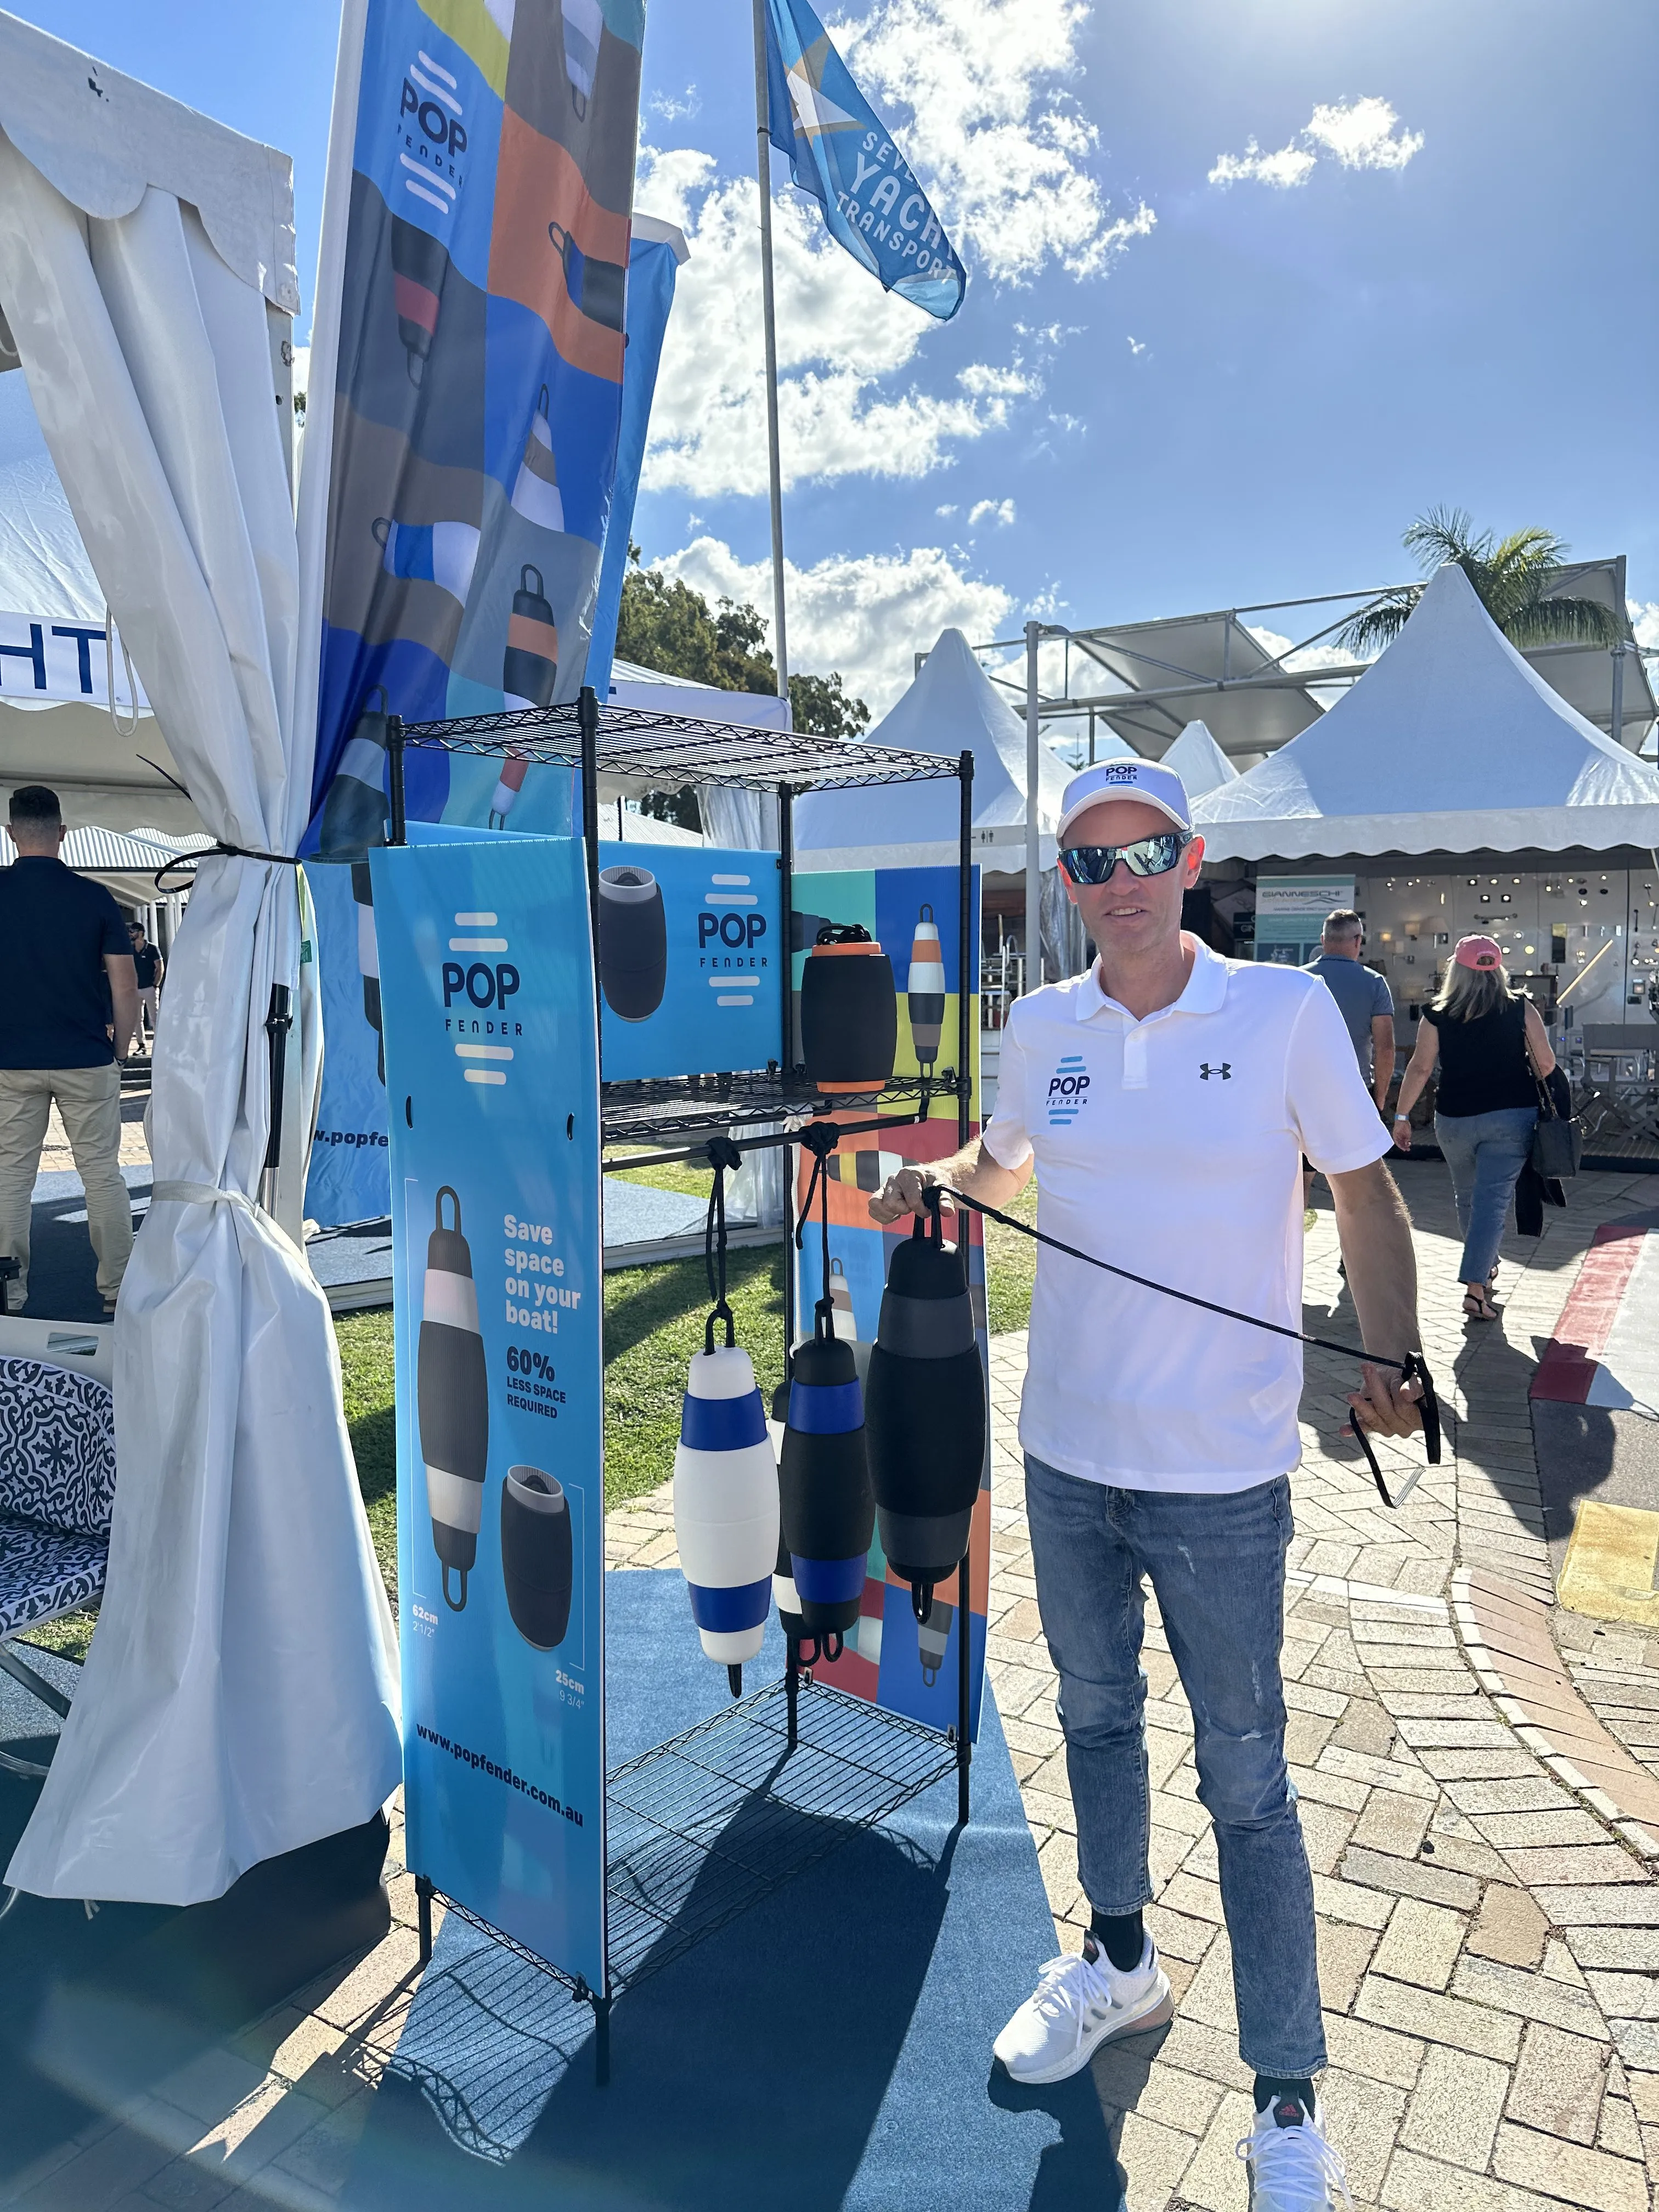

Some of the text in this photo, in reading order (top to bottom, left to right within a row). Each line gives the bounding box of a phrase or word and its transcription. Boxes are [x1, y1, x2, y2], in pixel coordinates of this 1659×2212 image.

[400, 77, 467, 157] POP
[397, 123, 463, 189] FENDER
[836, 191, 956, 284] TRANSPORT
[1106, 766, 1137, 776] POP
[698, 913, 766, 949] POP
[700, 957, 768, 968] FENDER
[442, 962, 520, 1010] POP
[445, 1018, 523, 1036] FENDER
[1048, 1076, 1090, 1097] POP
[504, 1214, 553, 1245] Save
[504, 1248, 565, 1277] space
[505, 1277, 581, 1310] on your
[506, 1300, 558, 1334] boat!
[506, 1346, 555, 1382] 60%
[507, 1375, 566, 1404] LESS SPACE
[507, 1393, 558, 1419] REQUIRED
[413, 1604, 438, 1625] 62cm
[555, 1669, 584, 1695] 25cm
[560, 1690, 565, 1701] 9
[416, 1723, 584, 1828] www.popfender.com.au
